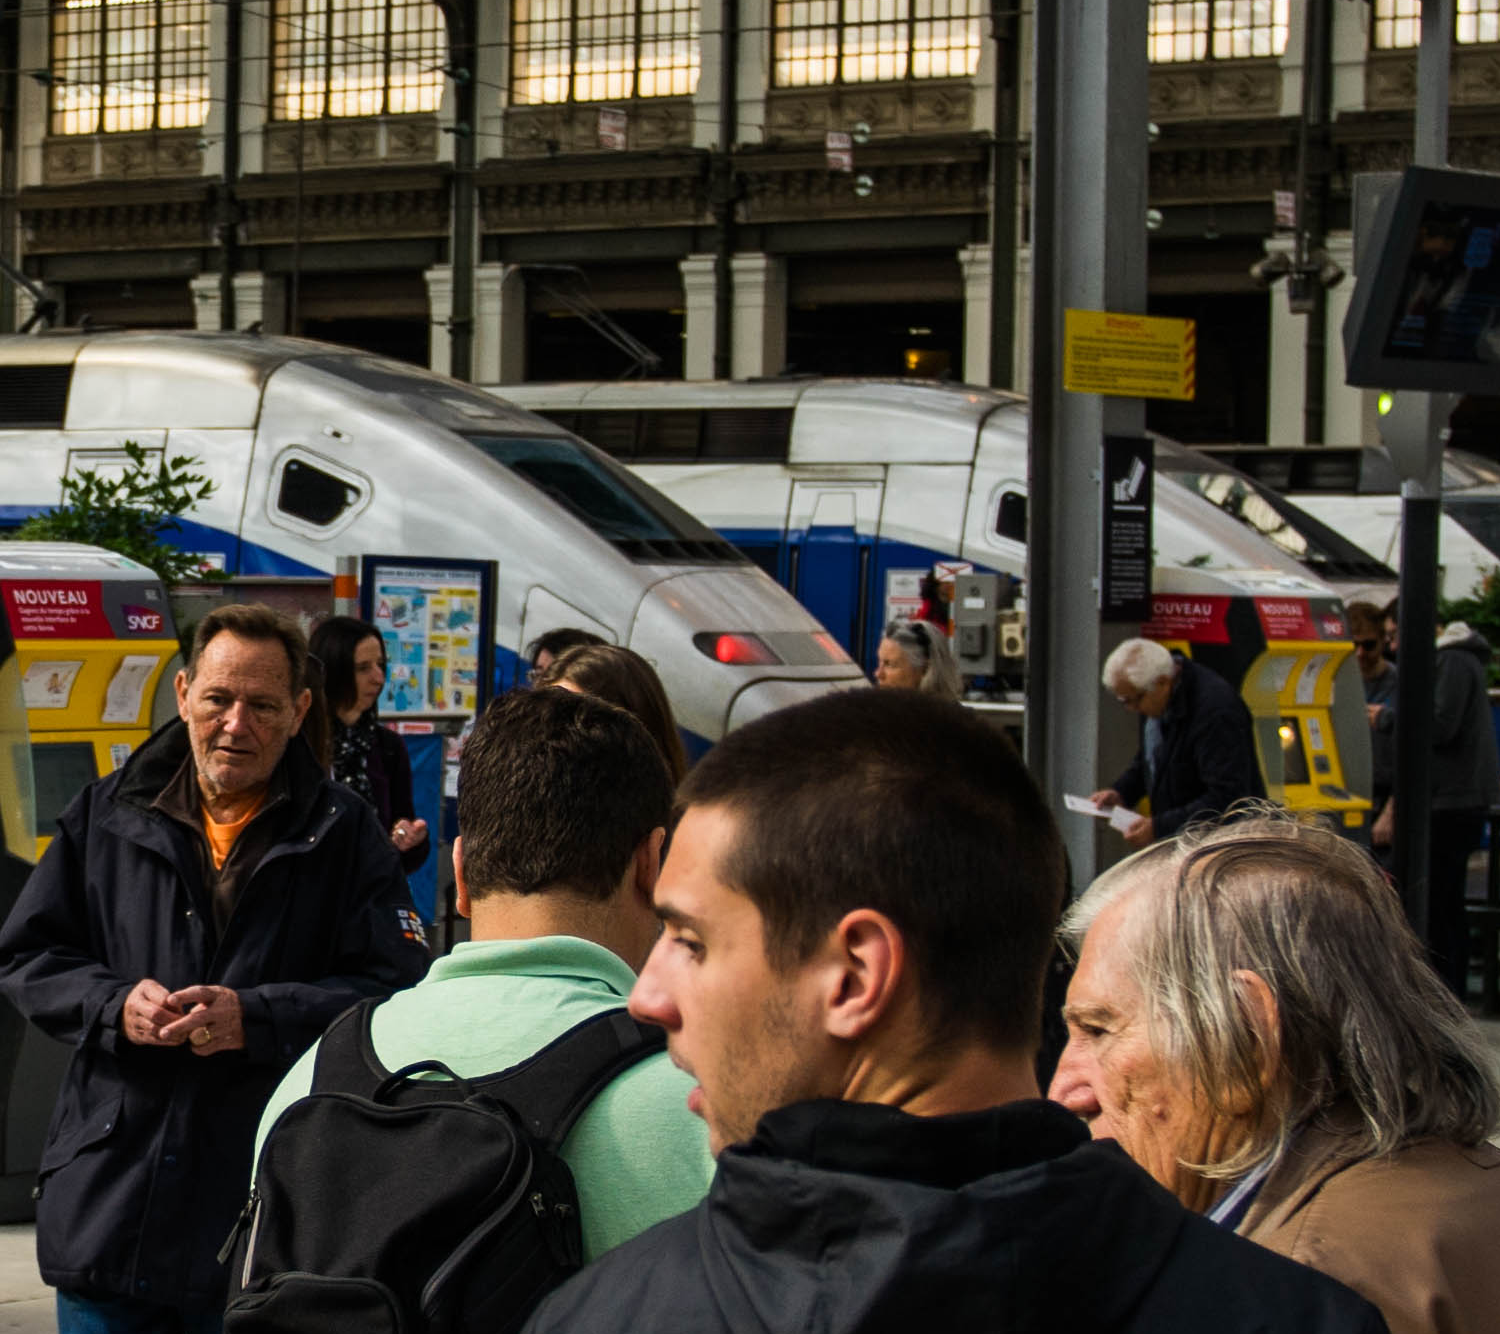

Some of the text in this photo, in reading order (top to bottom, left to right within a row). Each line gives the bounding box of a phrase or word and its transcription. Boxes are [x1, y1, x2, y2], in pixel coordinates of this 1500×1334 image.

[13, 588, 89, 605] NOUVEAU
[1153, 603, 1213, 616] OUVEAU
[127, 614, 161, 631] SNCF
